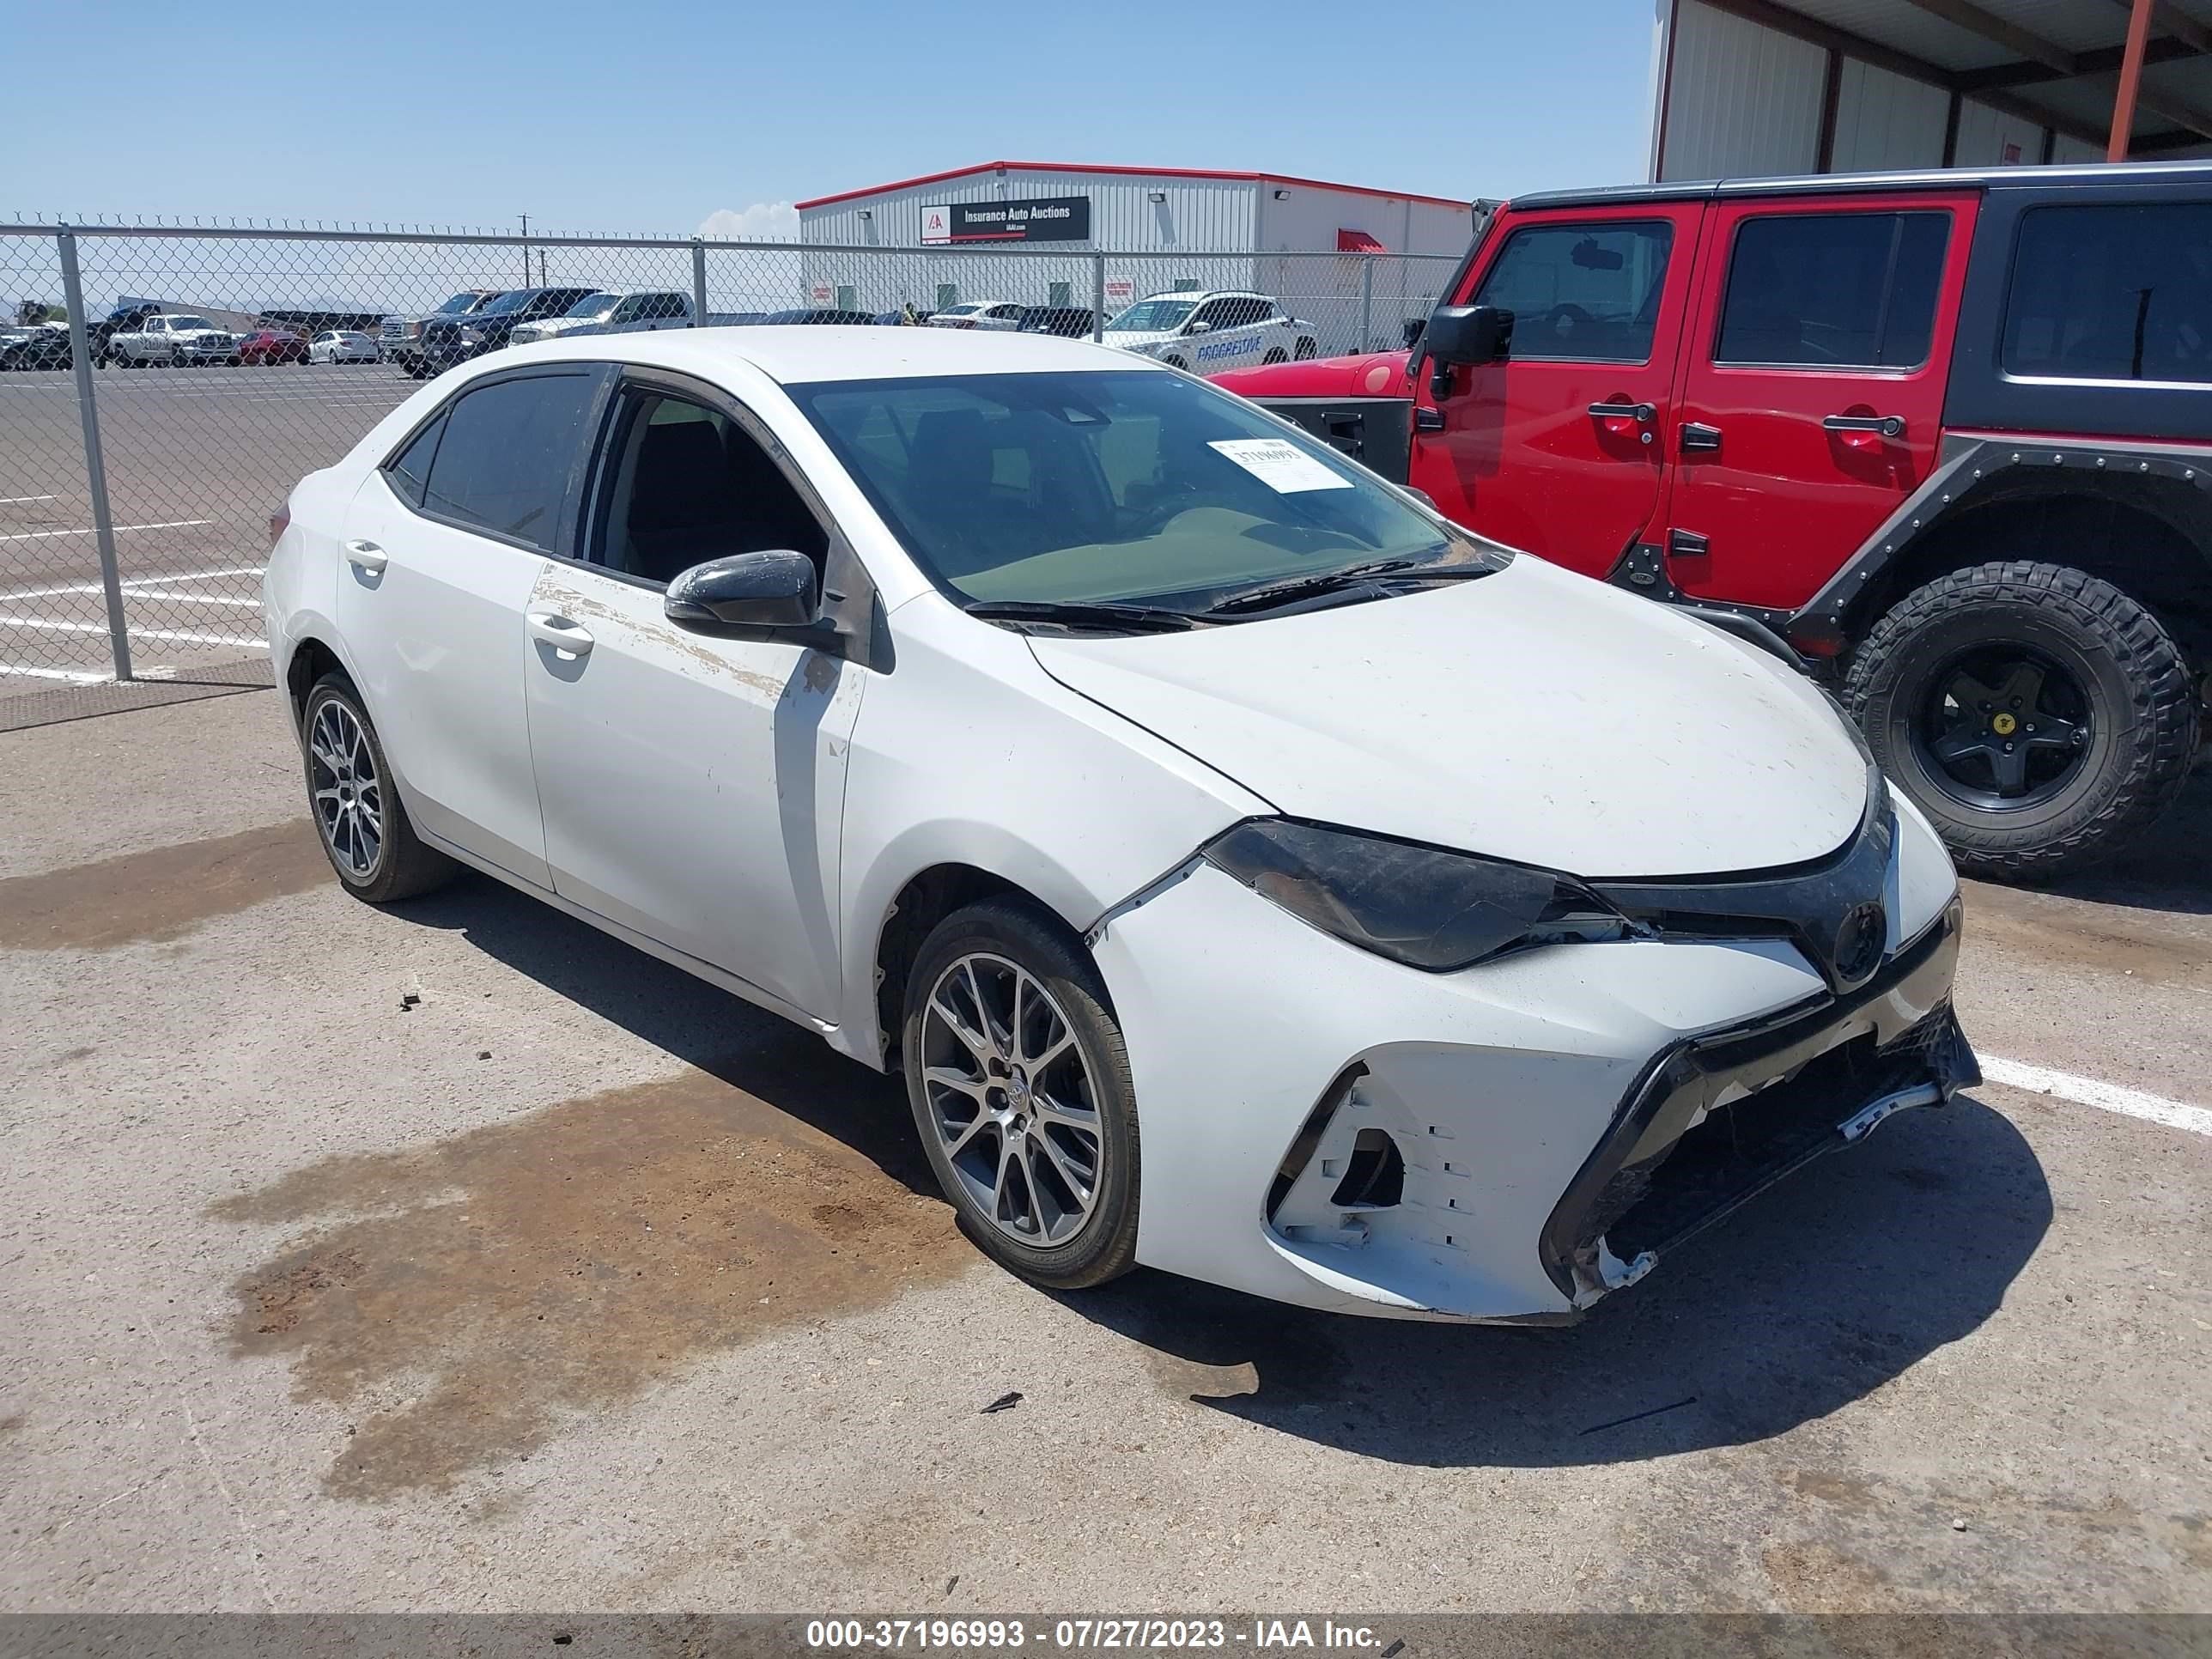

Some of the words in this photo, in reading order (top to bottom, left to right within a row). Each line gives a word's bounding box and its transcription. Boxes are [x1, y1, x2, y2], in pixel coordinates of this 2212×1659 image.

[965, 210, 1006, 222] Insurance
[1008, 207, 1029, 221] Auto
[1030, 205, 1071, 220] Auctions
[1197, 336, 1262, 362] PROGRESSIVE
[1234, 449, 1302, 463] 37196993
